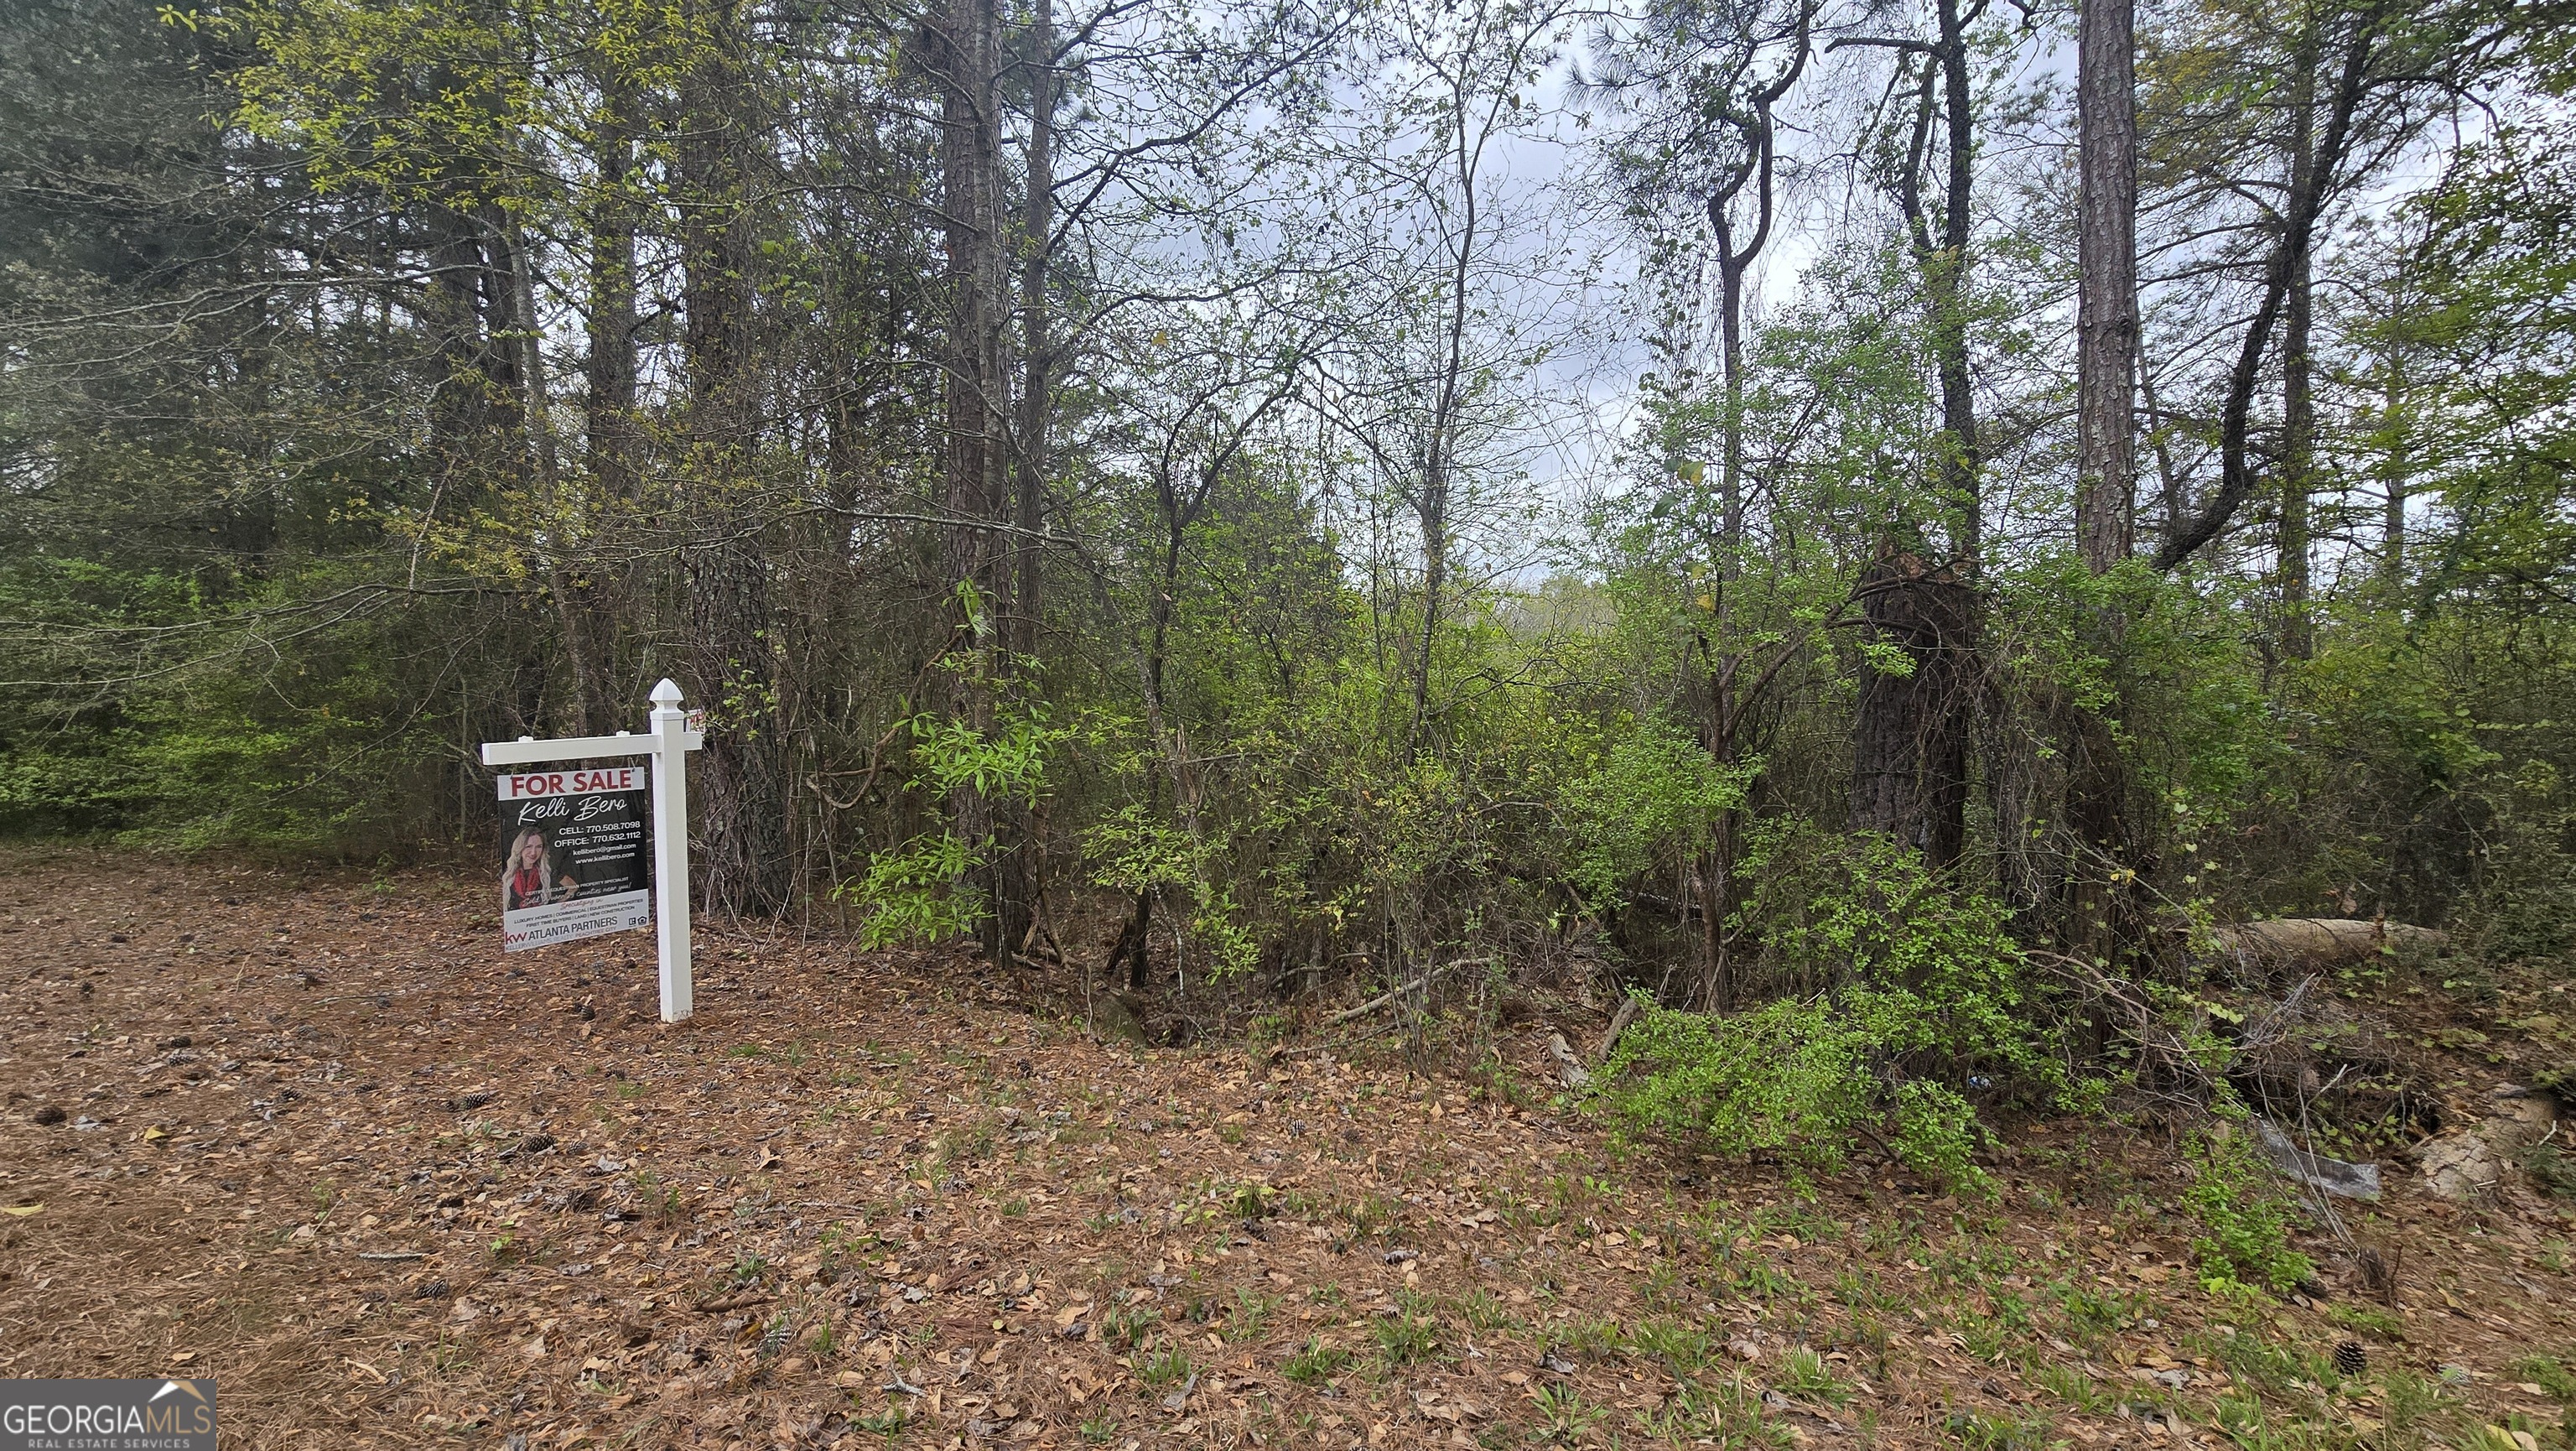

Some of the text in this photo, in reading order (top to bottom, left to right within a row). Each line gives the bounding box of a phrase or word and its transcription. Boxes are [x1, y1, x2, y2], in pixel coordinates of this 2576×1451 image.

[511, 769, 631, 797] FOR SALE
[517, 796, 627, 826] Kelli Bero
[558, 821, 641, 835] CELL: 770.508.7098
[554, 831, 641, 848] OFFICE: 770.632.1112
[573, 843, 636, 856] kellibero@gmail.com
[575, 852, 636, 865] www.kellibero.com
[601, 906, 635, 914] CONSTRUCTION
[505, 916, 618, 944] kw ATLANTA PARTNERS
